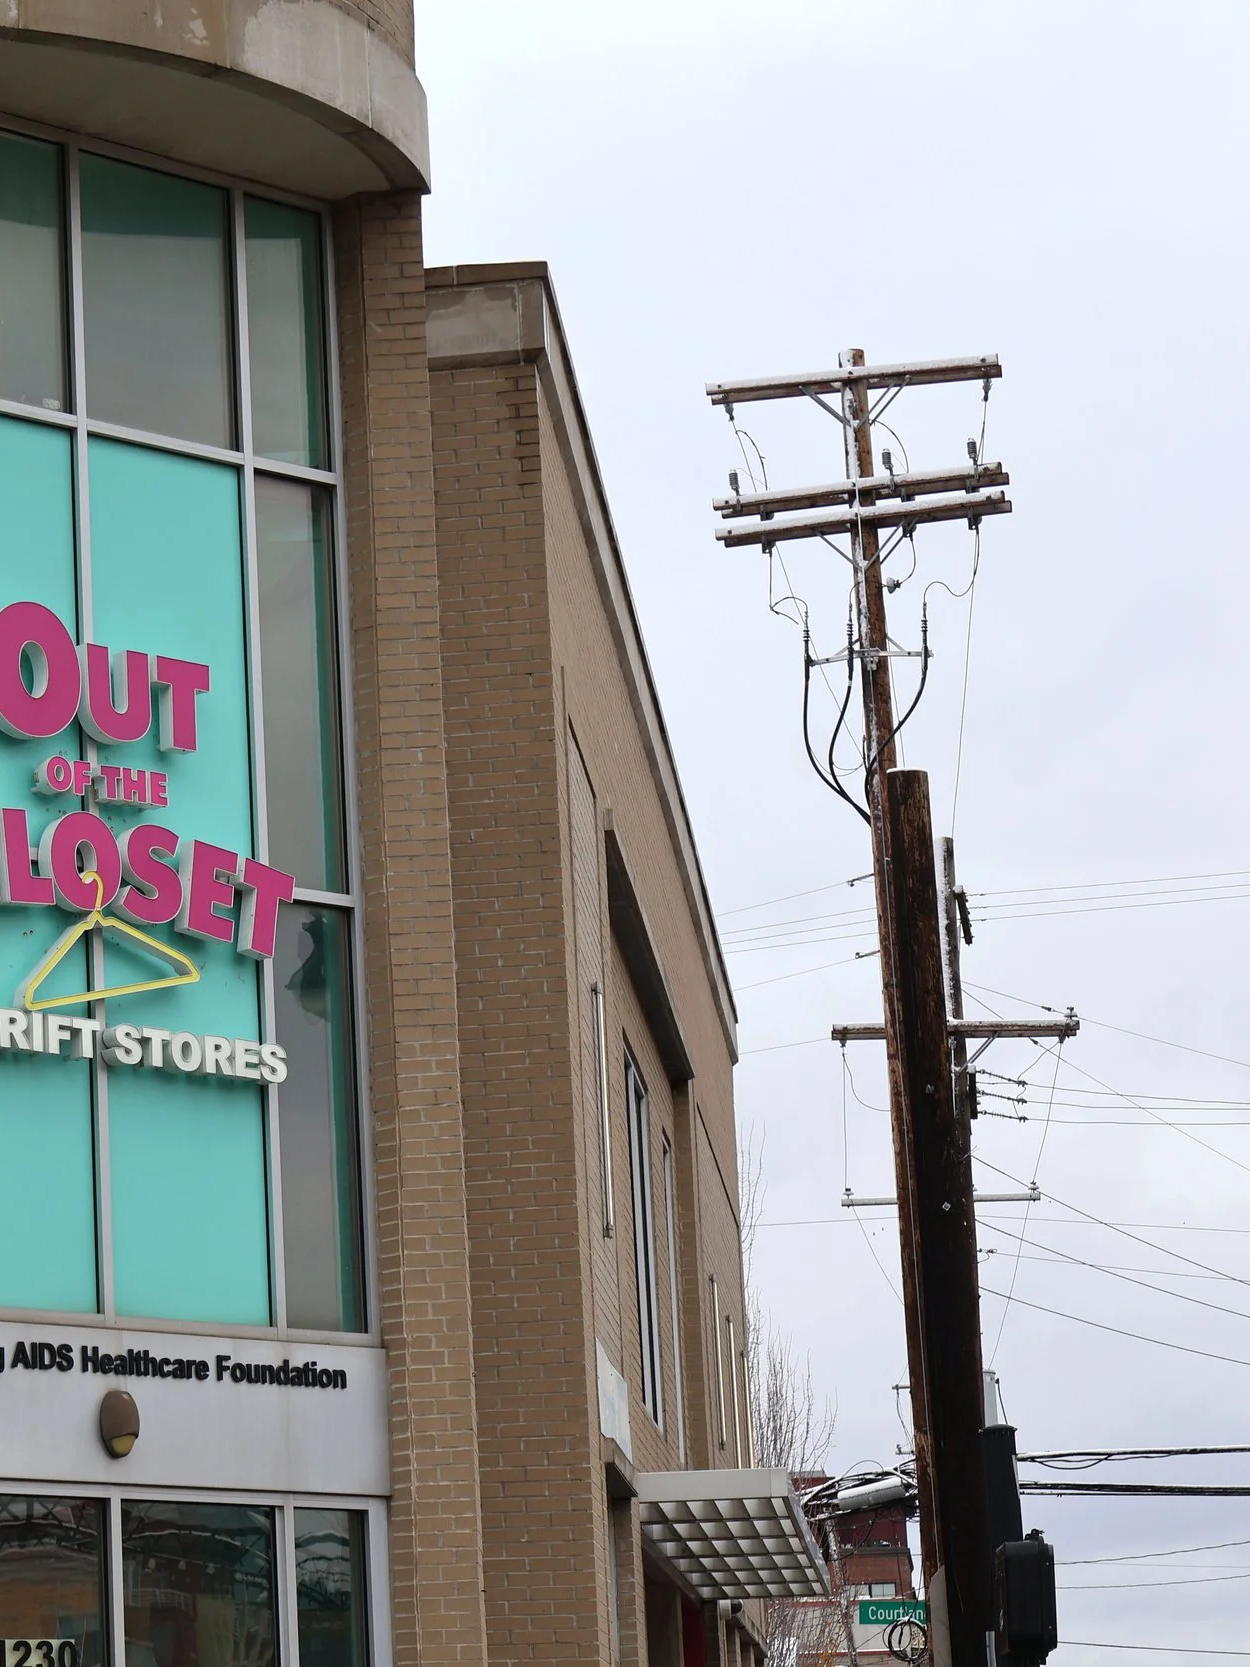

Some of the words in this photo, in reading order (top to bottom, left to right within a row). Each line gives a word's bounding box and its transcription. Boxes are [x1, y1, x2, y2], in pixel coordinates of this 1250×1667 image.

[39, 755, 92, 797] OF
[96, 764, 168, 808] THE
[103, 1024, 288, 1084] STORES
[11, 1341, 75, 1372] AIDS
[81, 1345, 210, 1381] Healthcare
[216, 1354, 347, 1389] Foundation
